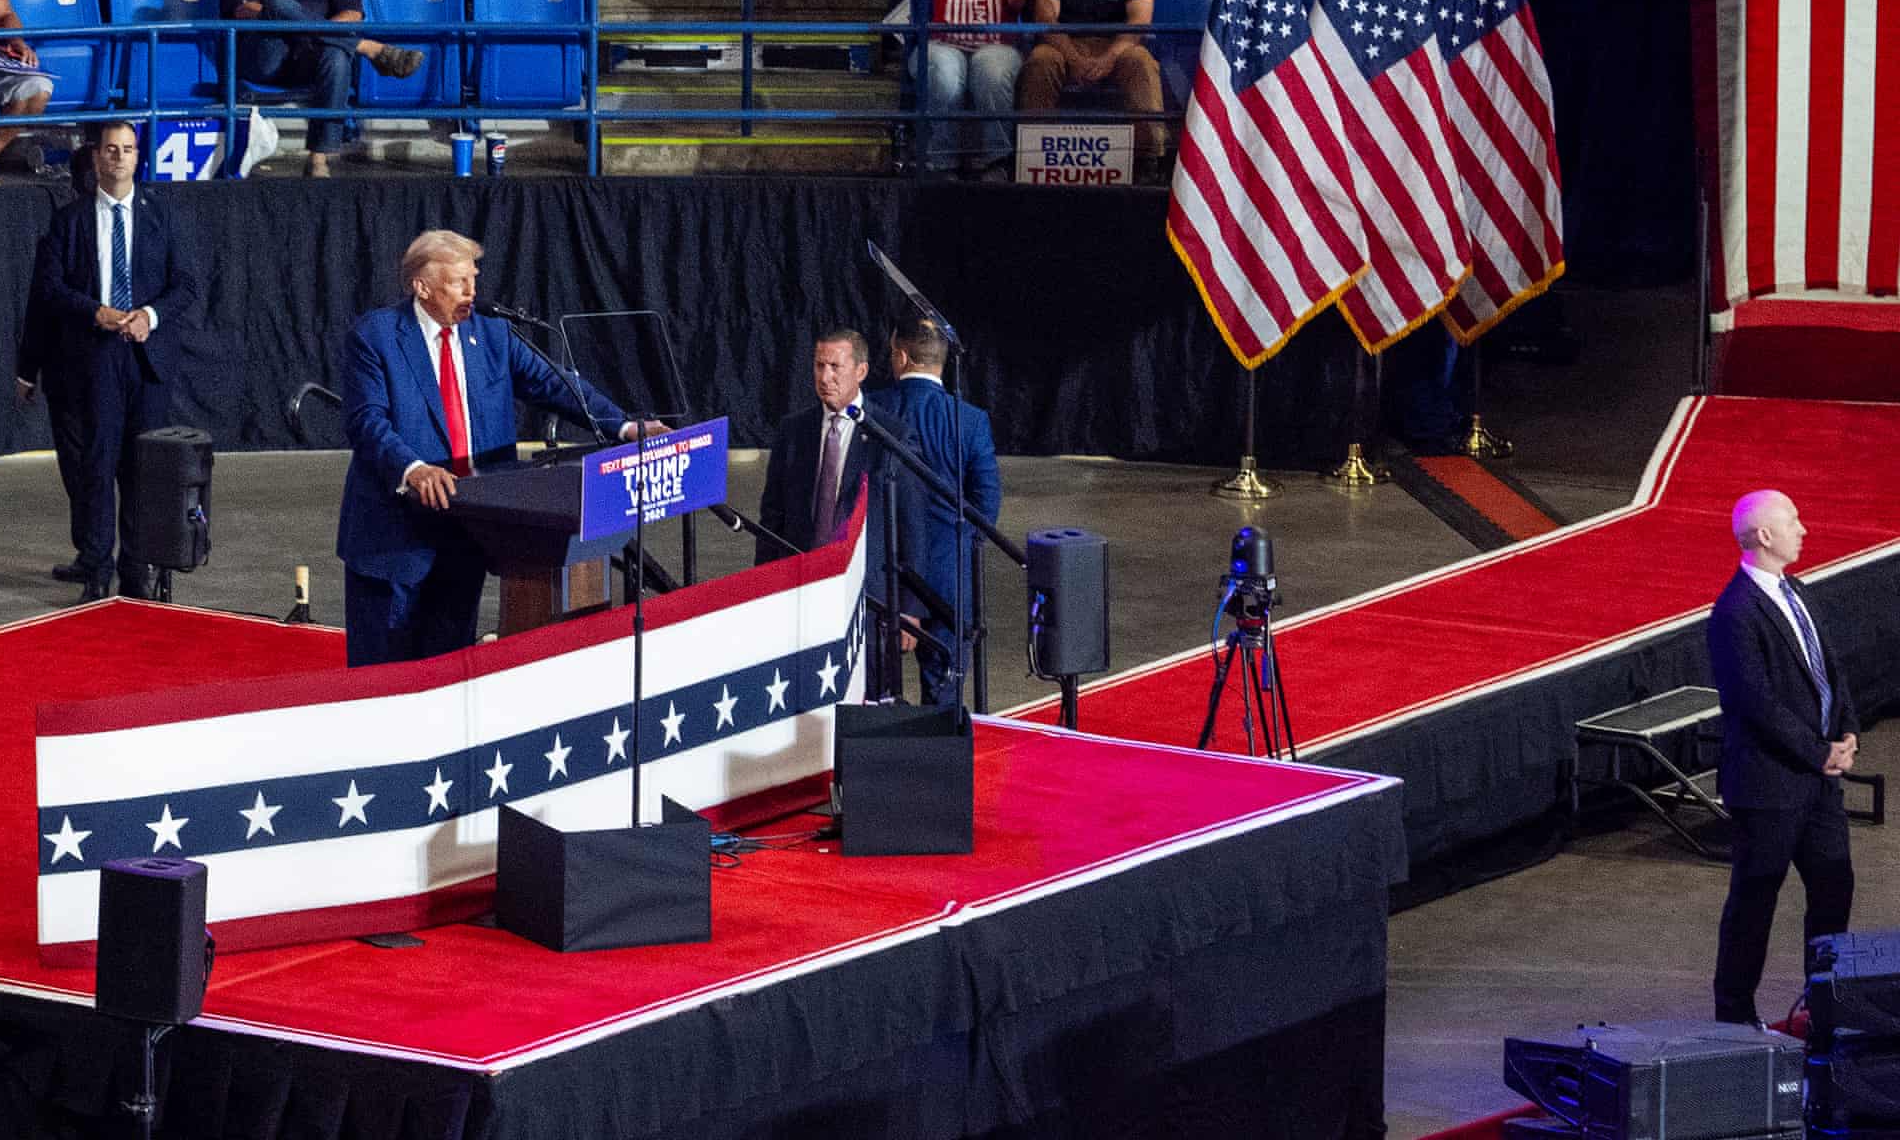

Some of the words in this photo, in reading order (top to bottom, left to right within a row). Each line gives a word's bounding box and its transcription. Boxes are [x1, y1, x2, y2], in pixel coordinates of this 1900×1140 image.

[1041, 136, 1110, 152] BRING
[156, 131, 227, 182] 47
[1044, 151, 1106, 167] BACK
[1028, 168, 1122, 185] TRUMP
[622, 453, 690, 491] TRUMP
[630, 477, 683, 508] VANCE
